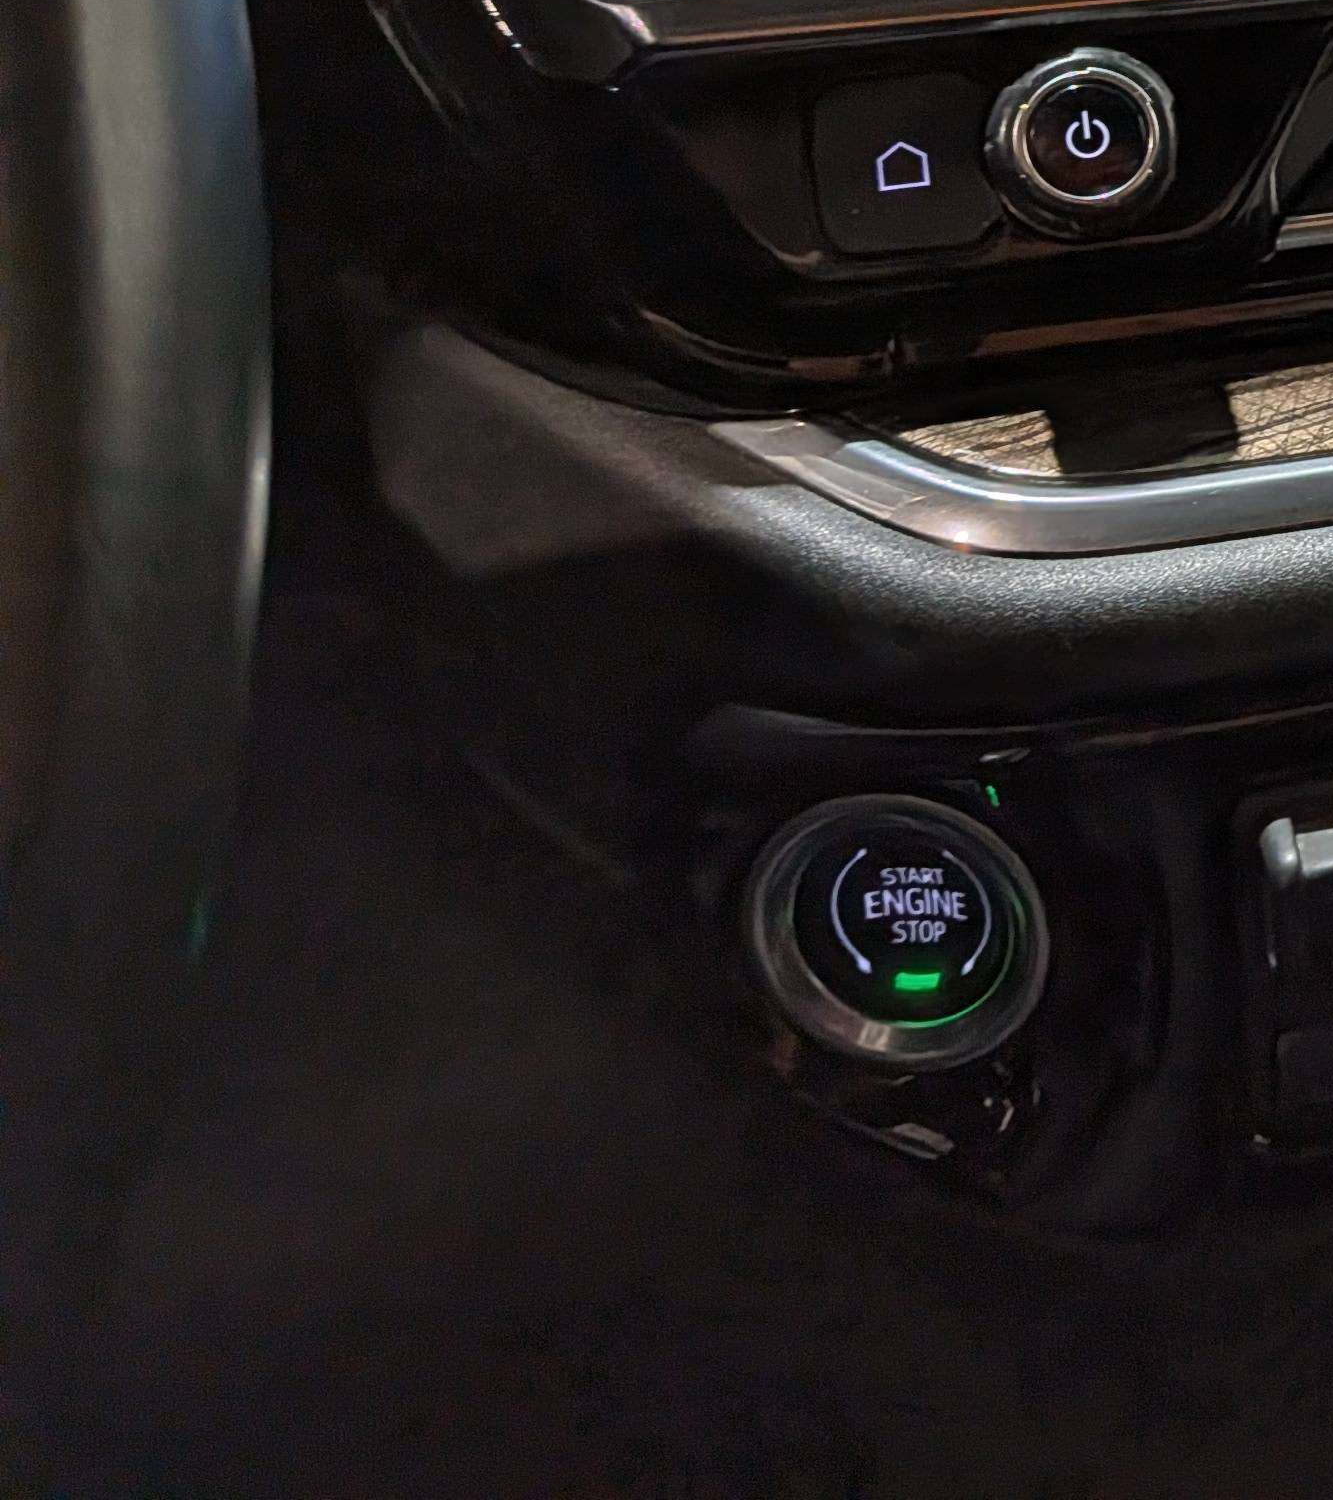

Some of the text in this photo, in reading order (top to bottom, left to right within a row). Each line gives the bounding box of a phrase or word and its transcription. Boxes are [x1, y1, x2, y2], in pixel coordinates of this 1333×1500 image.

[879, 867, 944, 887] START
[863, 887, 969, 921] ENGINE
[890, 920, 948, 945] STOP
